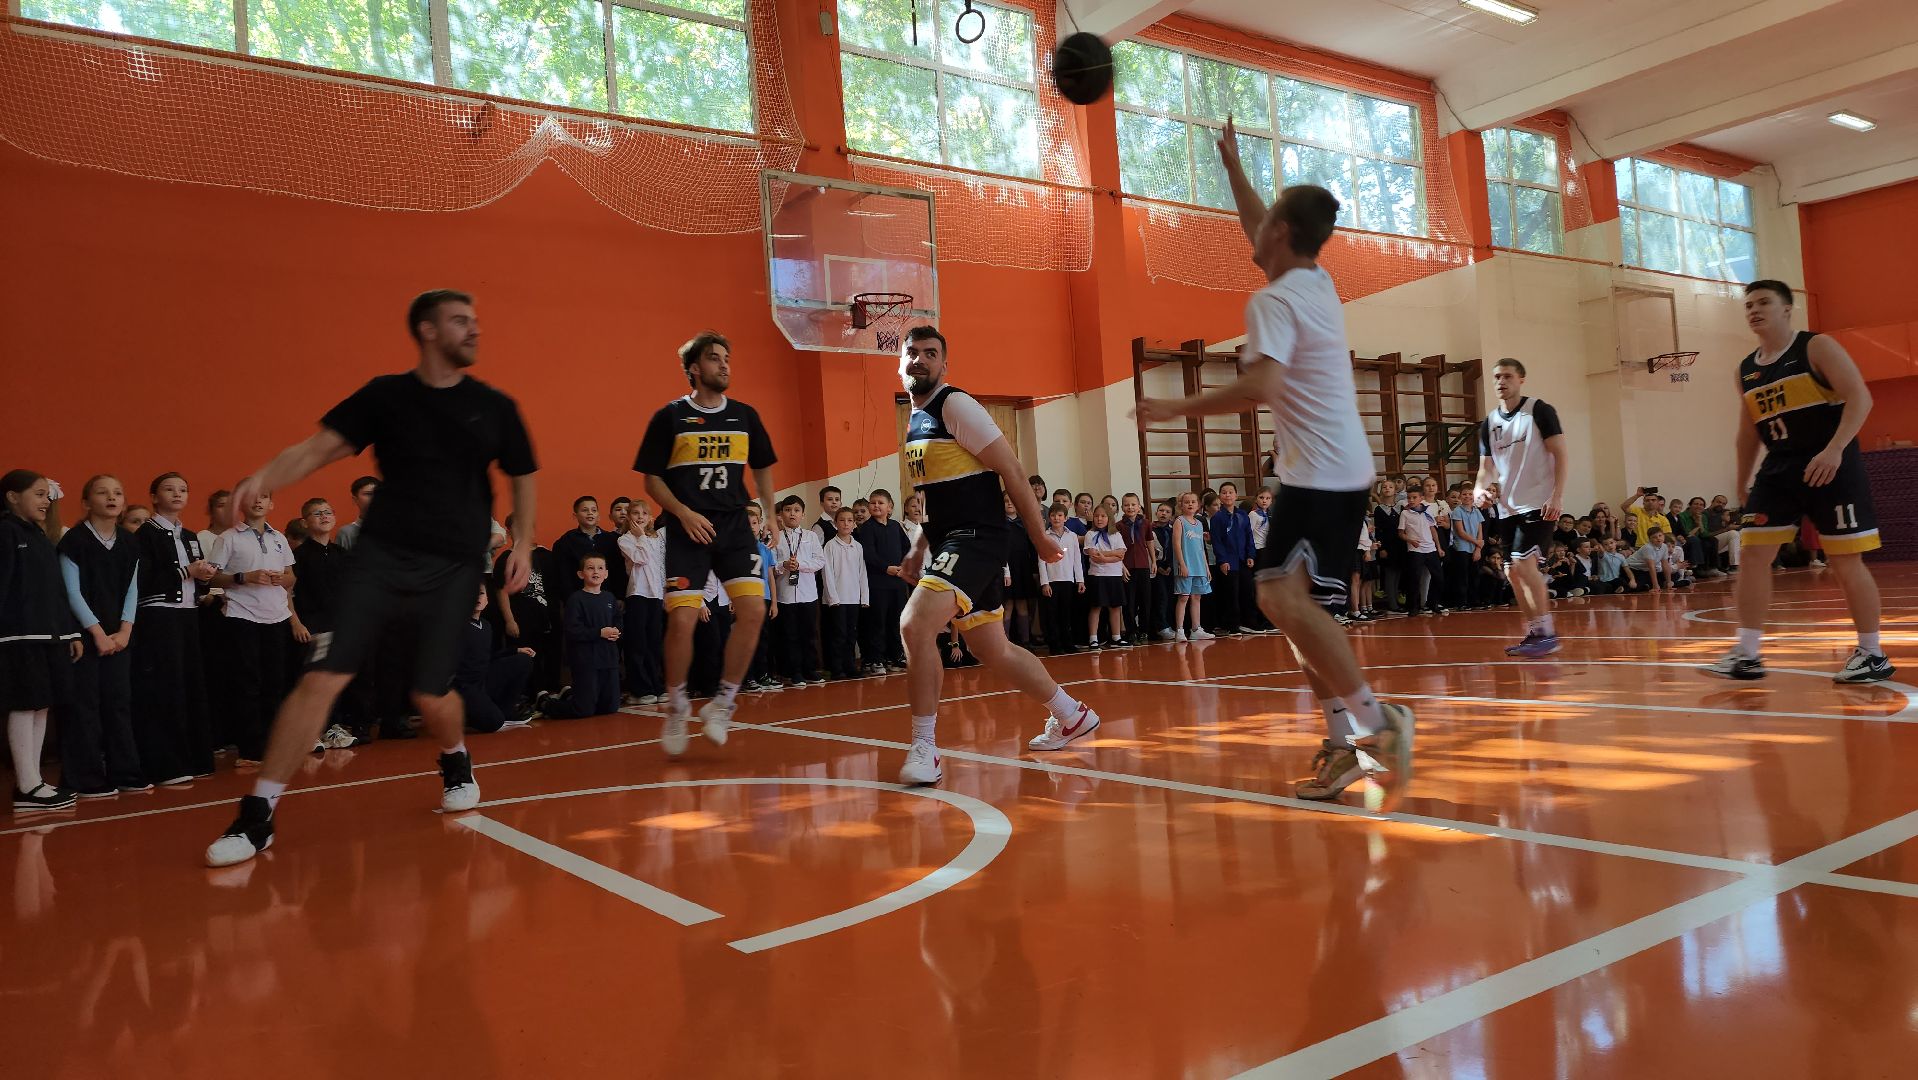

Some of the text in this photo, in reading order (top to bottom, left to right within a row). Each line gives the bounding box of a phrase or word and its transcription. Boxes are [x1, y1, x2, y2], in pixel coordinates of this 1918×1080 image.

[1768, 417, 1788, 440] 11
[699, 466, 728, 490] 73
[1834, 503, 1858, 529] 11
[932, 551, 960, 576] 91
